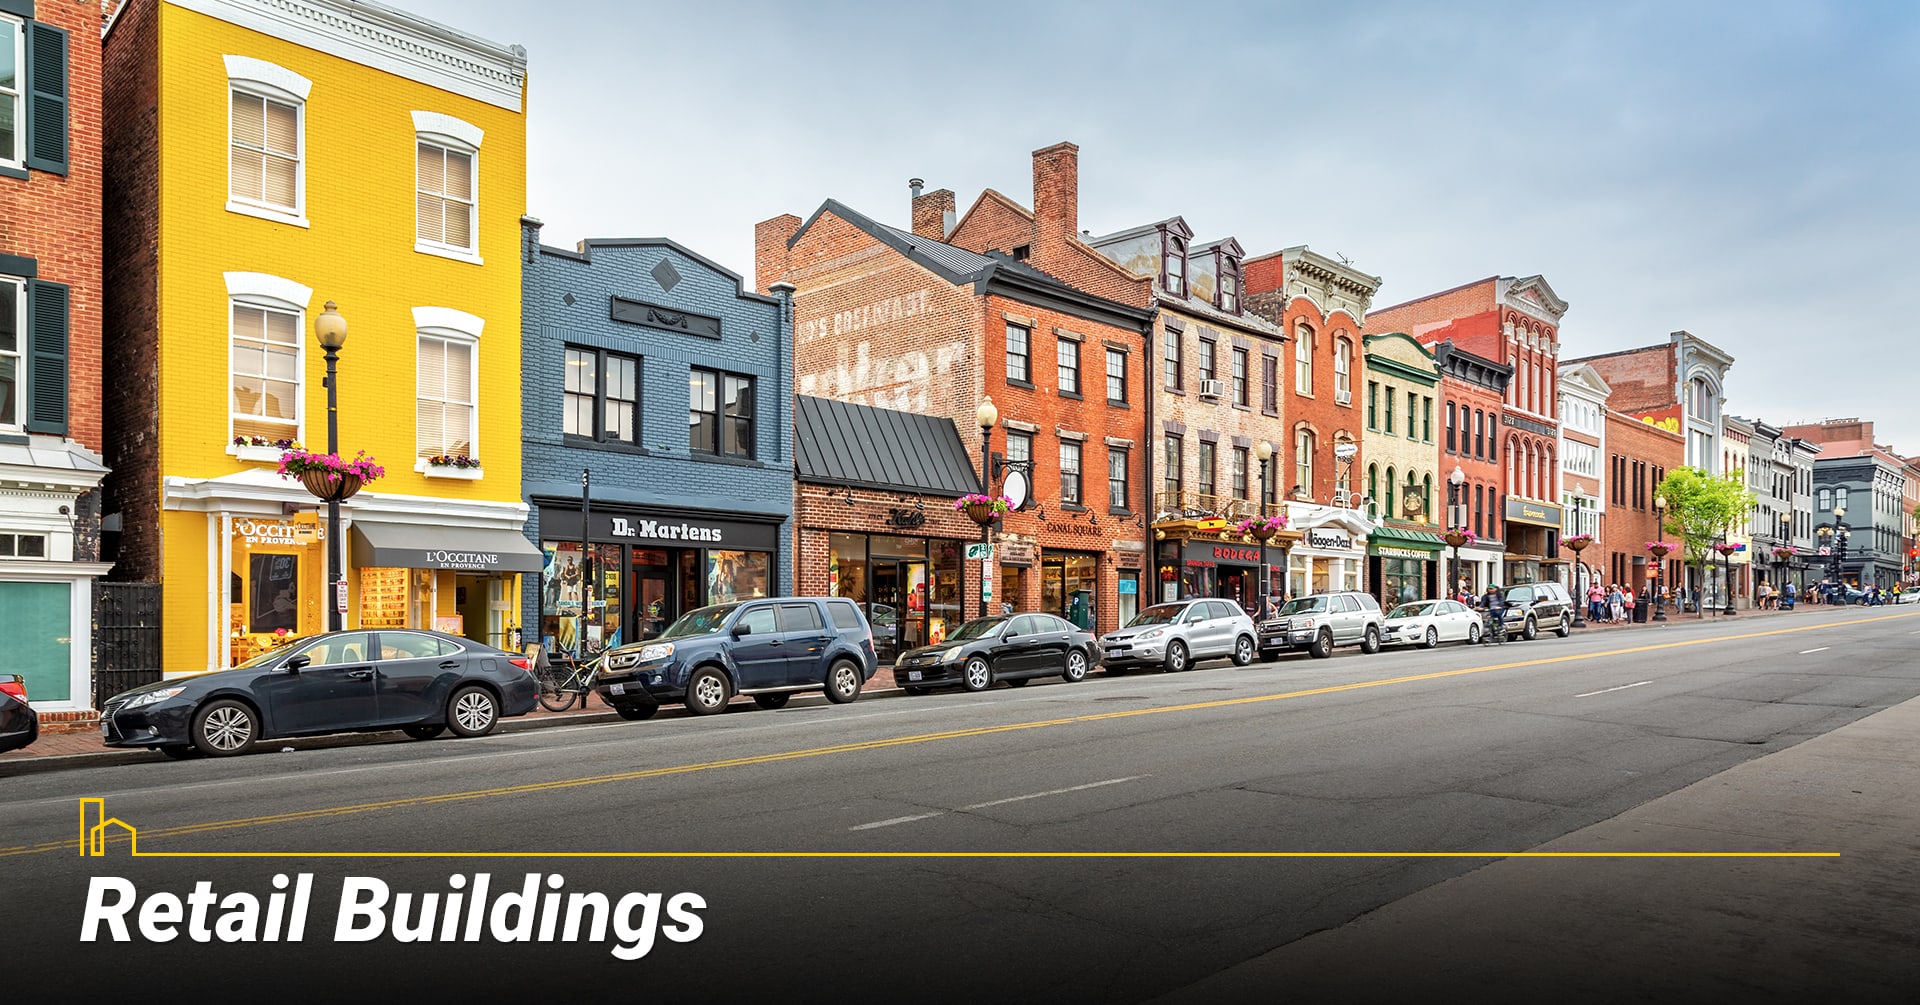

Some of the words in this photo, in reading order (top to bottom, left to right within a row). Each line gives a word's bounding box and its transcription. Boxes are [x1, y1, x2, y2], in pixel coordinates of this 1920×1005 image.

[612, 518, 636, 537] Dr.
[639, 520, 722, 542] Martens
[1047, 522, 1072, 533] CANAL
[1074, 525, 1102, 536] SQUARE
[245, 536, 259, 544] EN
[426, 550, 499, 564] L'OCCITANE
[1213, 546, 1260, 561] BODEGA
[1378, 546, 1410, 558] STARBUCKS
[1410, 550, 1431, 560] COFFEE
